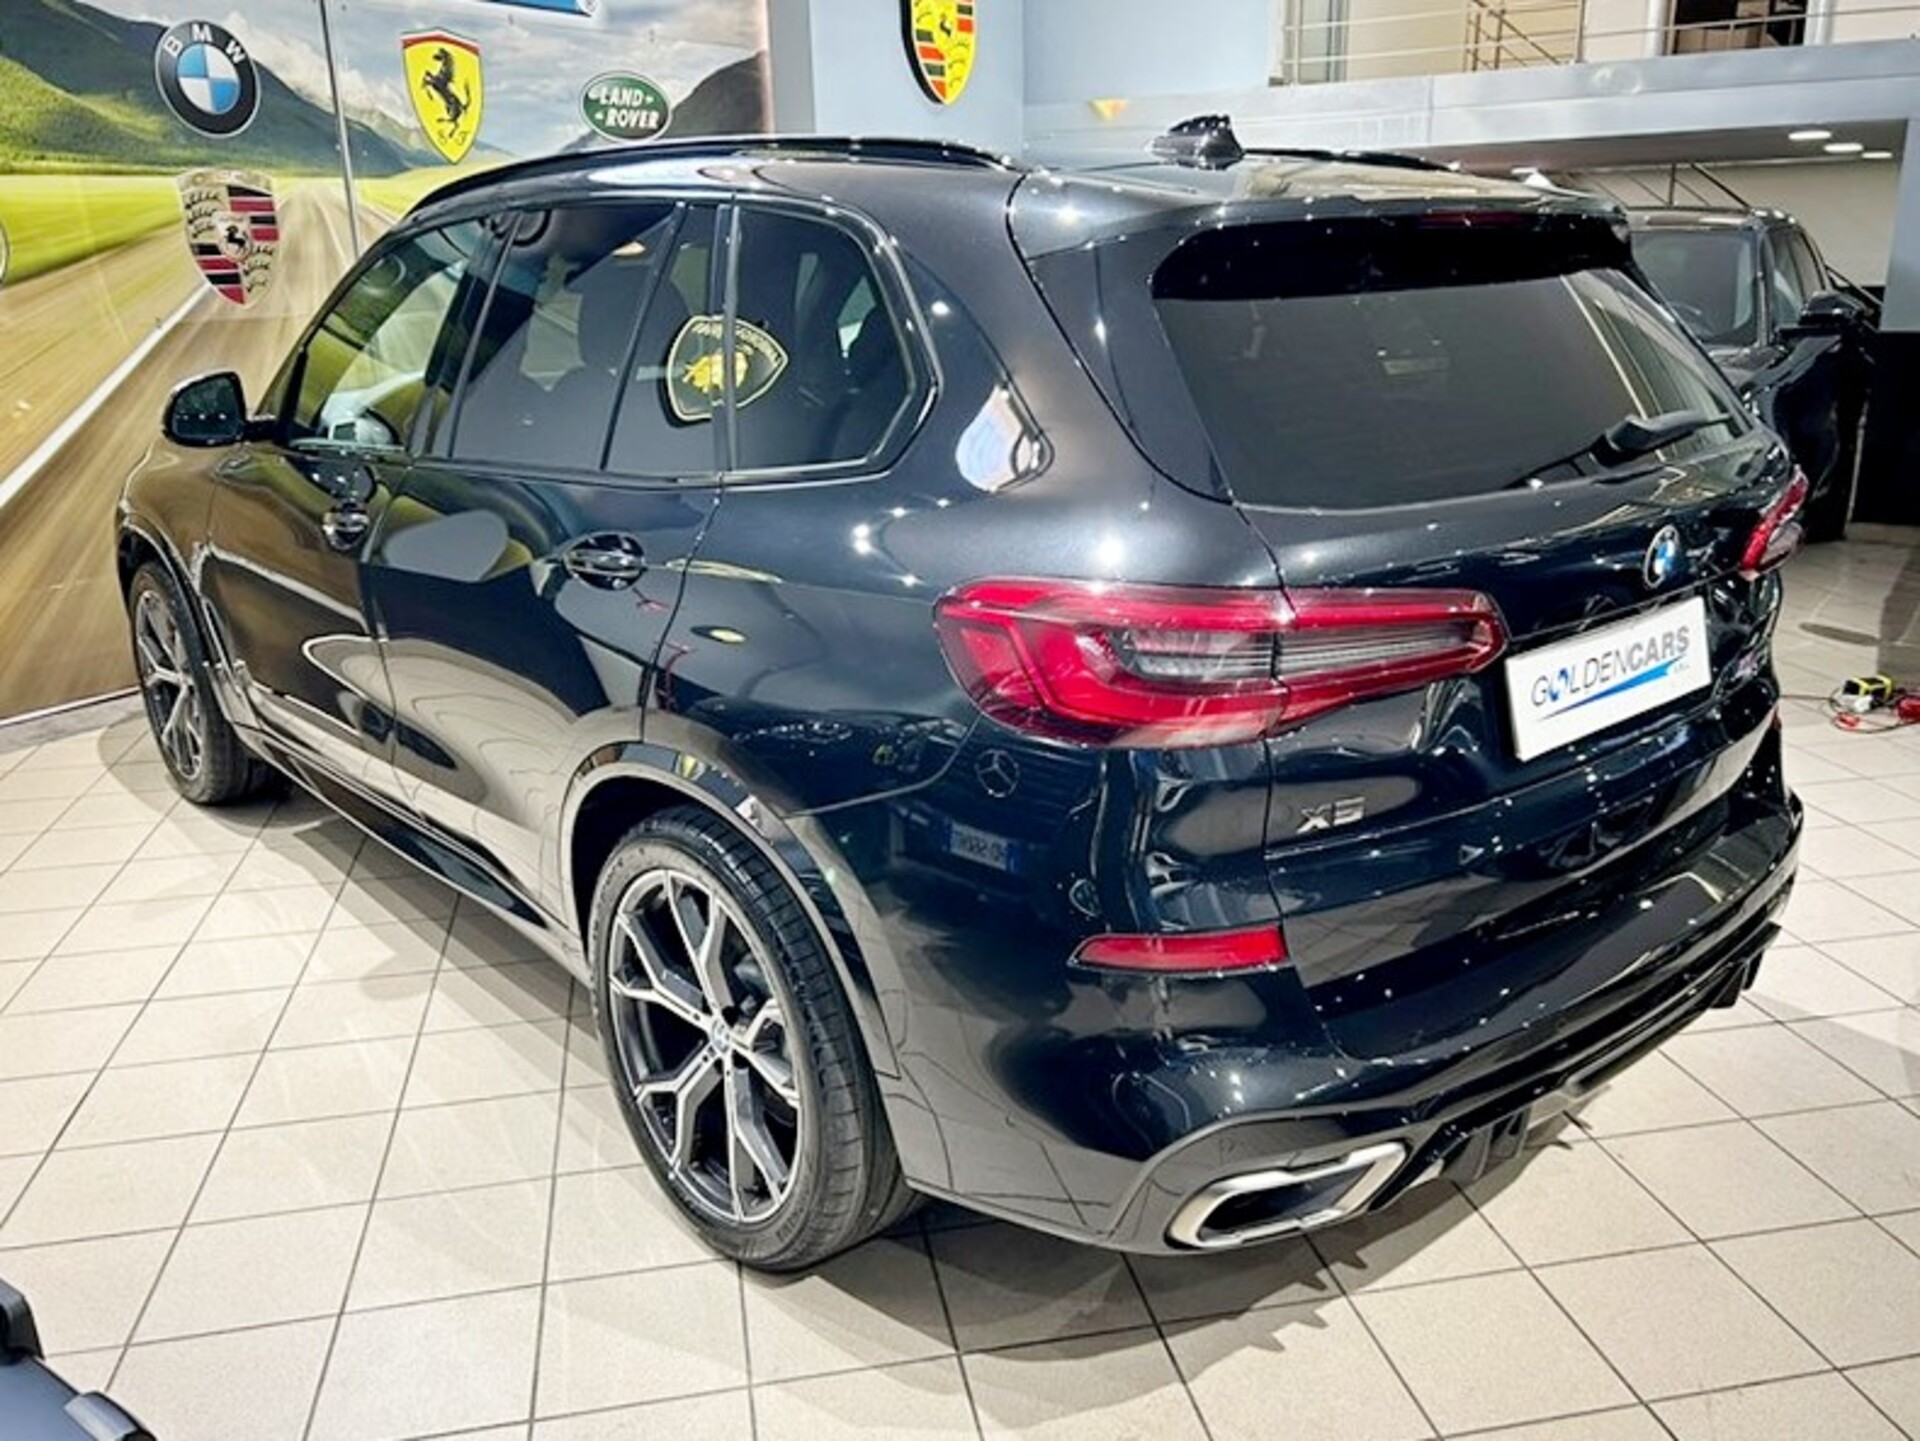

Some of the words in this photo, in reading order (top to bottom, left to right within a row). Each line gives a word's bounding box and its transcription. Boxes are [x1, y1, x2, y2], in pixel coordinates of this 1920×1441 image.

[163, 23, 246, 63] BMW
[600, 86, 645, 108] LAND
[605, 108, 660, 129] ROVER
[1530, 626, 1690, 707] GOLDENCARS
[1297, 797, 1365, 834] X5
